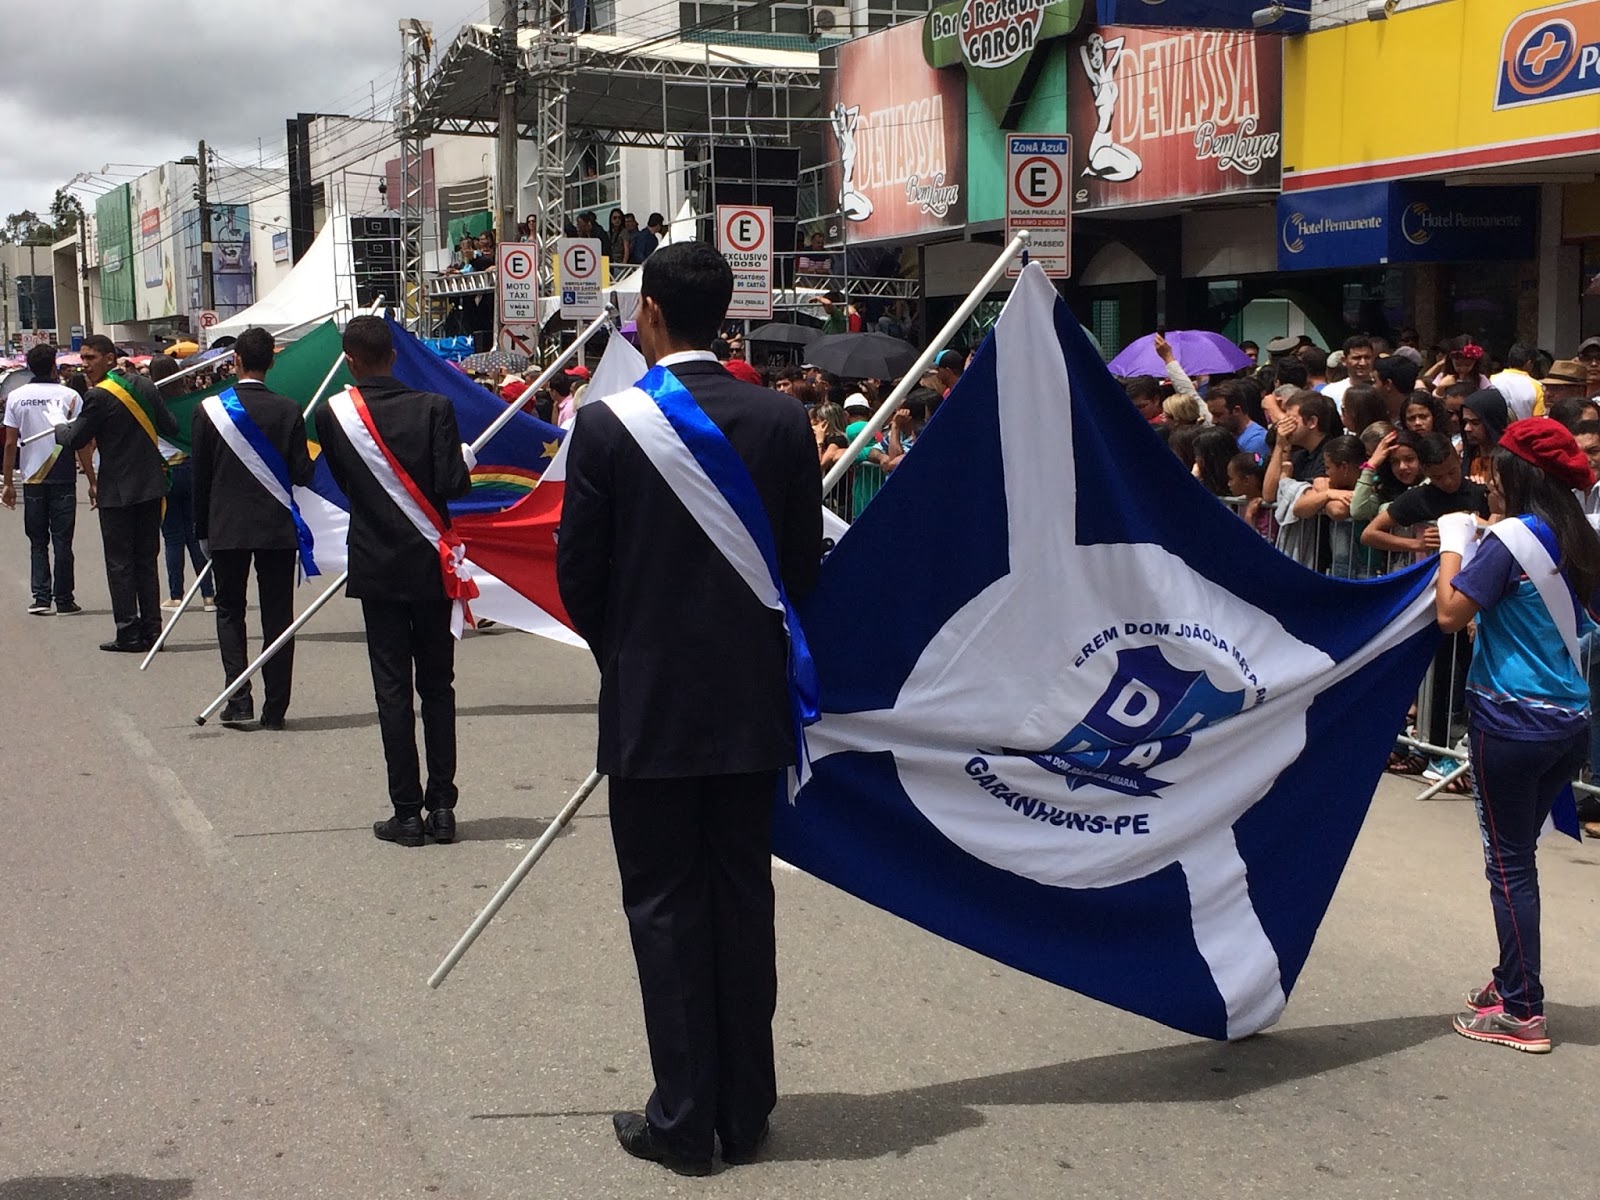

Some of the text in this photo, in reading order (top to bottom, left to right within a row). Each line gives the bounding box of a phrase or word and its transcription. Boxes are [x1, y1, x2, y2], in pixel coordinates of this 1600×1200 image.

[932, 13, 958, 39] Bar
[961, 11, 970, 30] e
[969, 20, 1033, 63] GARÔA
[1578, 45, 1600, 79] P
[1119, 31, 1259, 144] DEVASSA
[855, 94, 947, 191] DEVASSA
[1030, 167, 1047, 197] E
[740, 219, 751, 242] E
[1299, 216, 1382, 236] Hotel Permanente
[1421, 211, 1522, 229] Hotel Permanente
[1033, 240, 1065, 248] PASSEIO
[512, 257, 524, 273] E
[574, 250, 587, 272] E
[506, 283, 530, 291] MOTO
[1125, 622, 1170, 636] DOM
[1106, 677, 1160, 728] D
[964, 756, 1150, 835] GARANHUNS-PE
